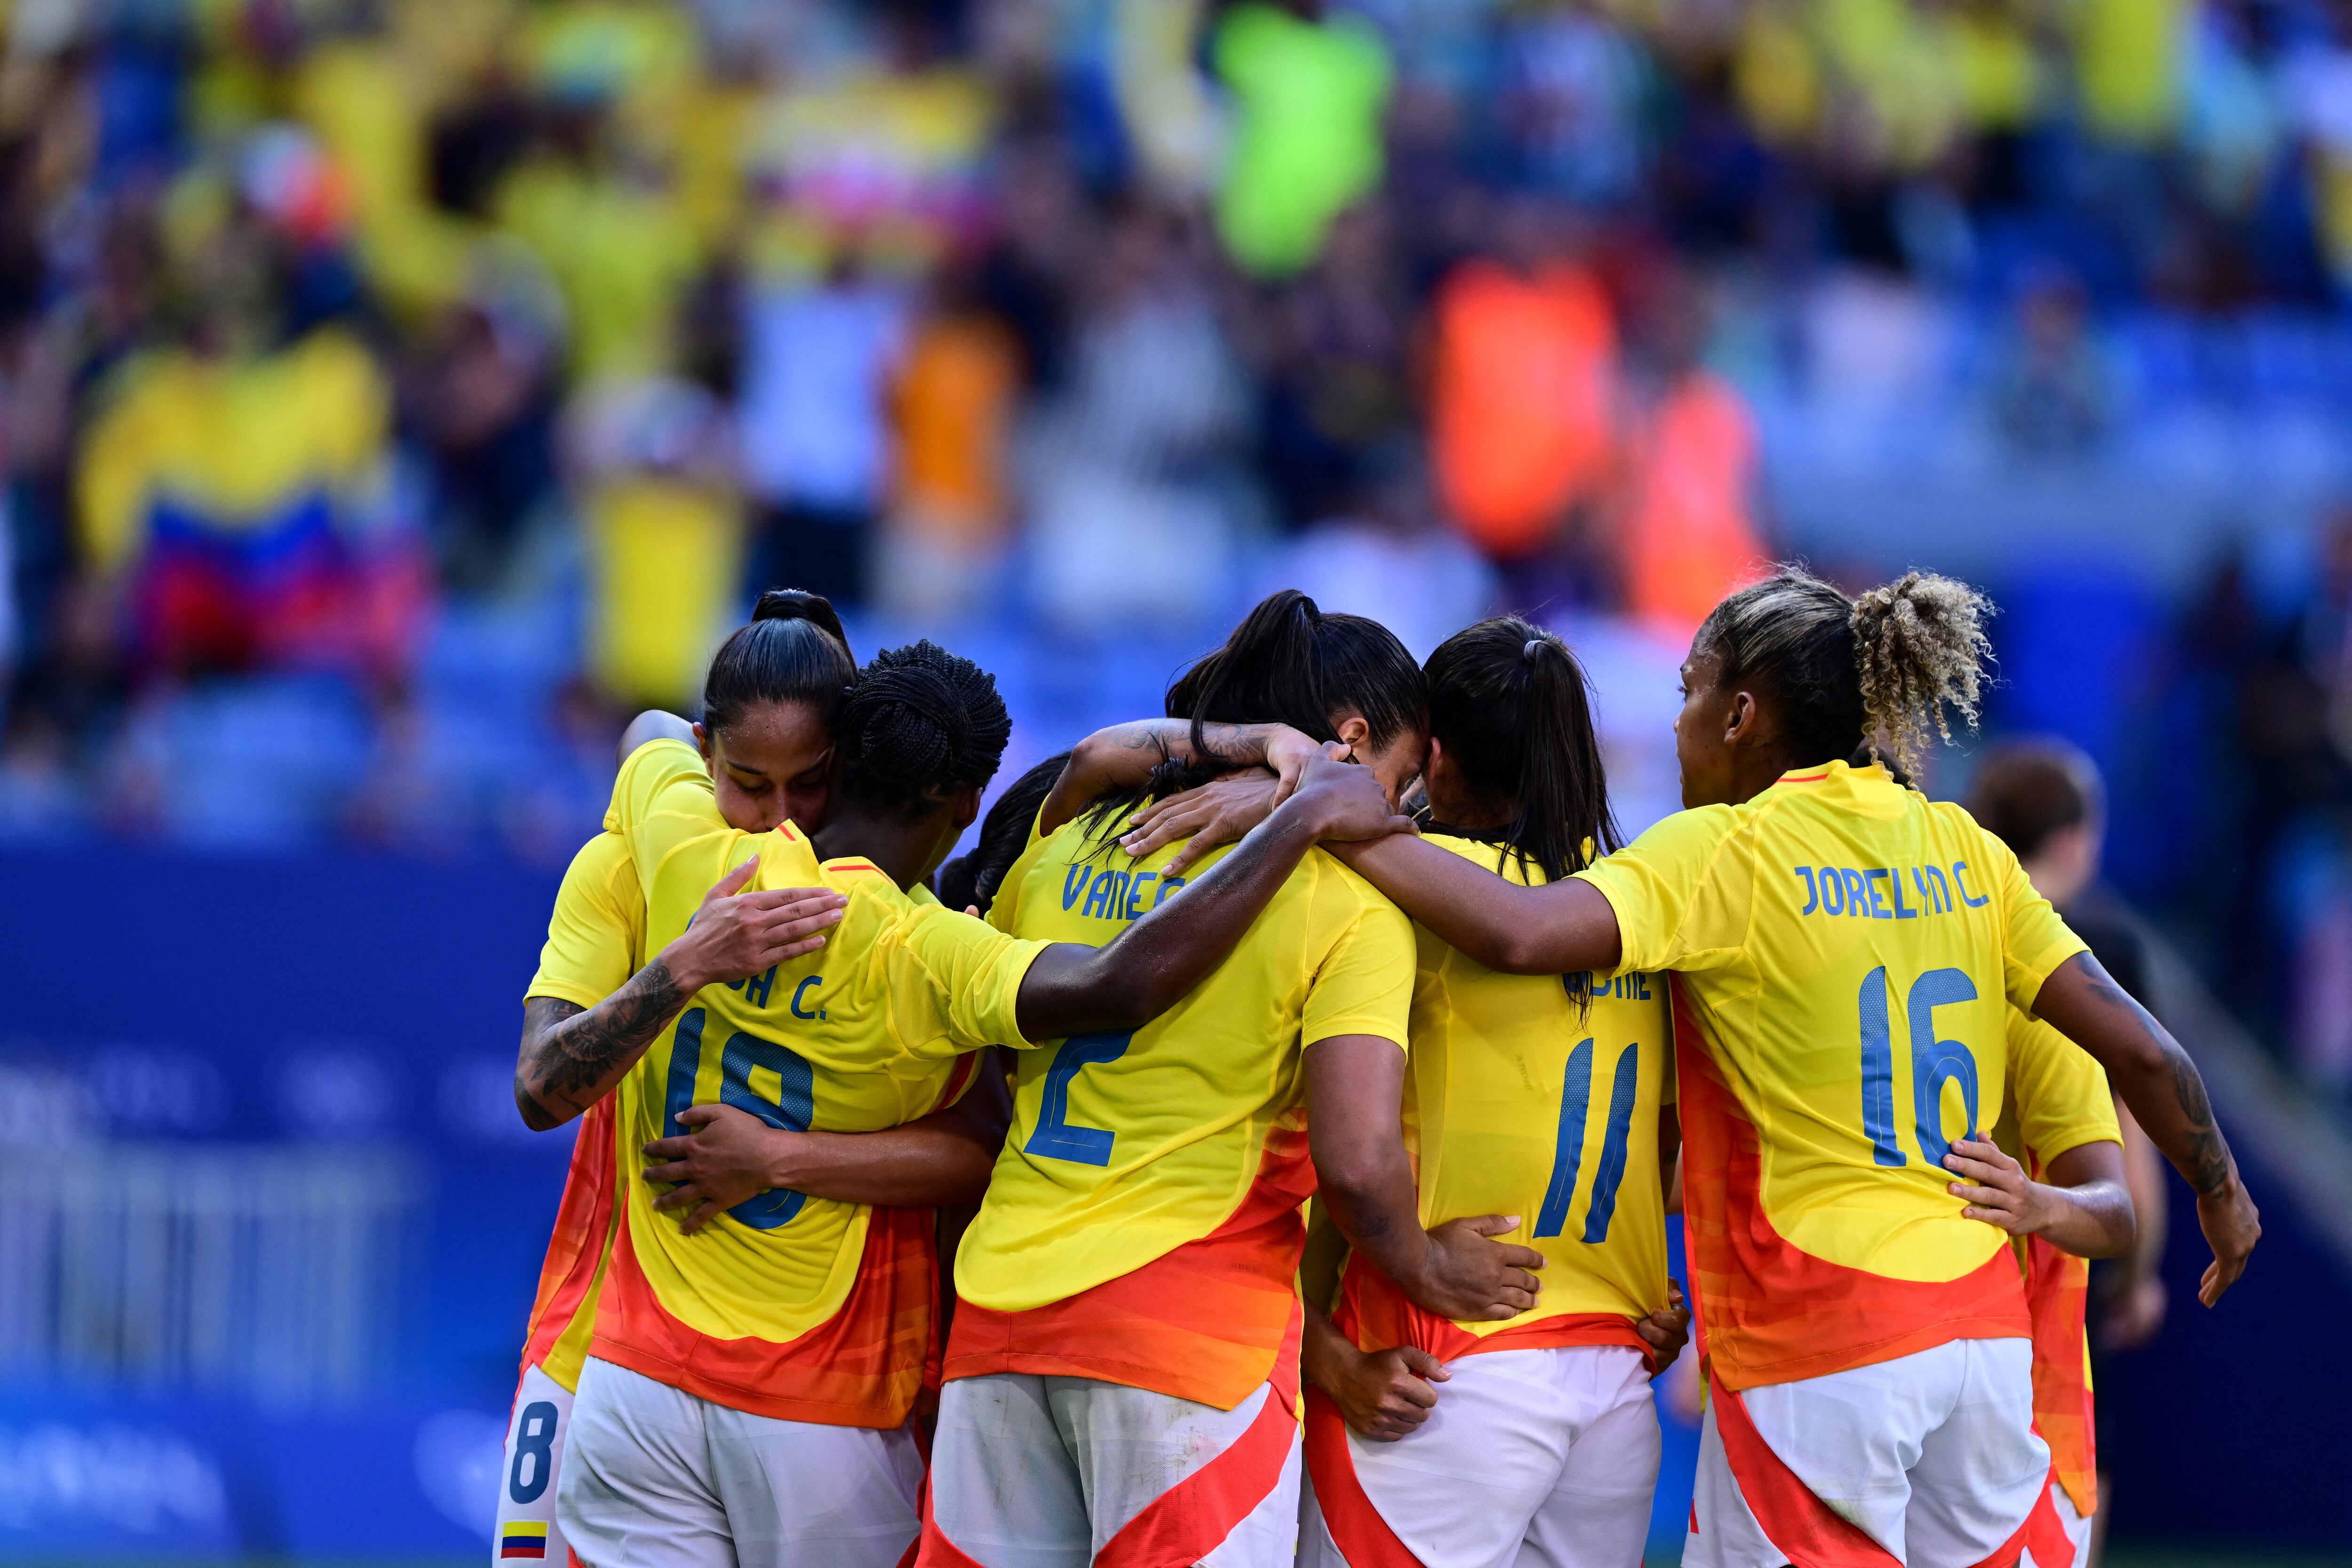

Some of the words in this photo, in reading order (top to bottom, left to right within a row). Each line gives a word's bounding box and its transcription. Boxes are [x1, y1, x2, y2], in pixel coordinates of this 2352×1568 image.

[1795, 866, 1952, 919] JORELYN
[1953, 861, 1989, 908] C.
[791, 975, 826, 1020] C.
[664, 1008, 813, 1229] 18
[1024, 1029, 1136, 1167] 2
[1533, 1038, 1638, 1244] 11
[1859, 966, 1978, 1178] 16
[509, 1401, 558, 1504] 8
